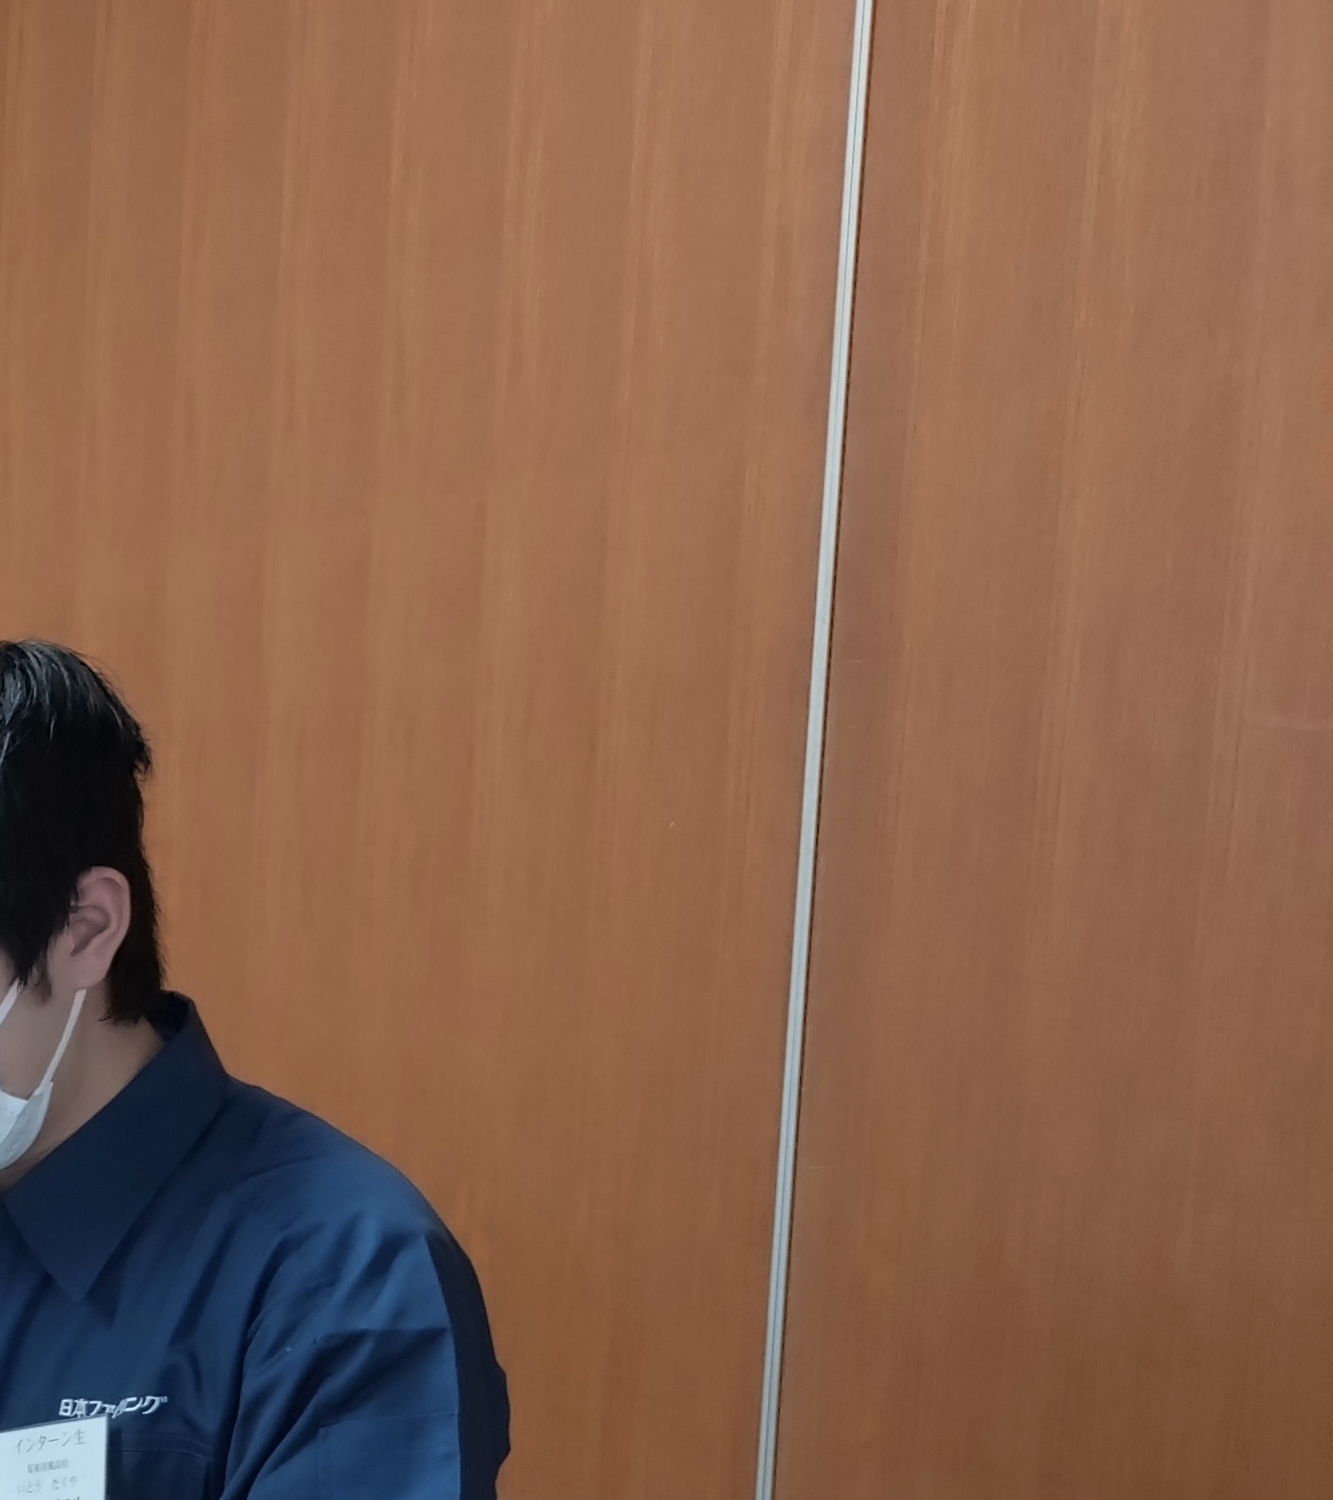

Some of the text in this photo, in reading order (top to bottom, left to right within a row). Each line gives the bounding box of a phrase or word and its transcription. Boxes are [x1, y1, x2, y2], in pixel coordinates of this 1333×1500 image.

[15, 1428, 86, 1454] インターン生
